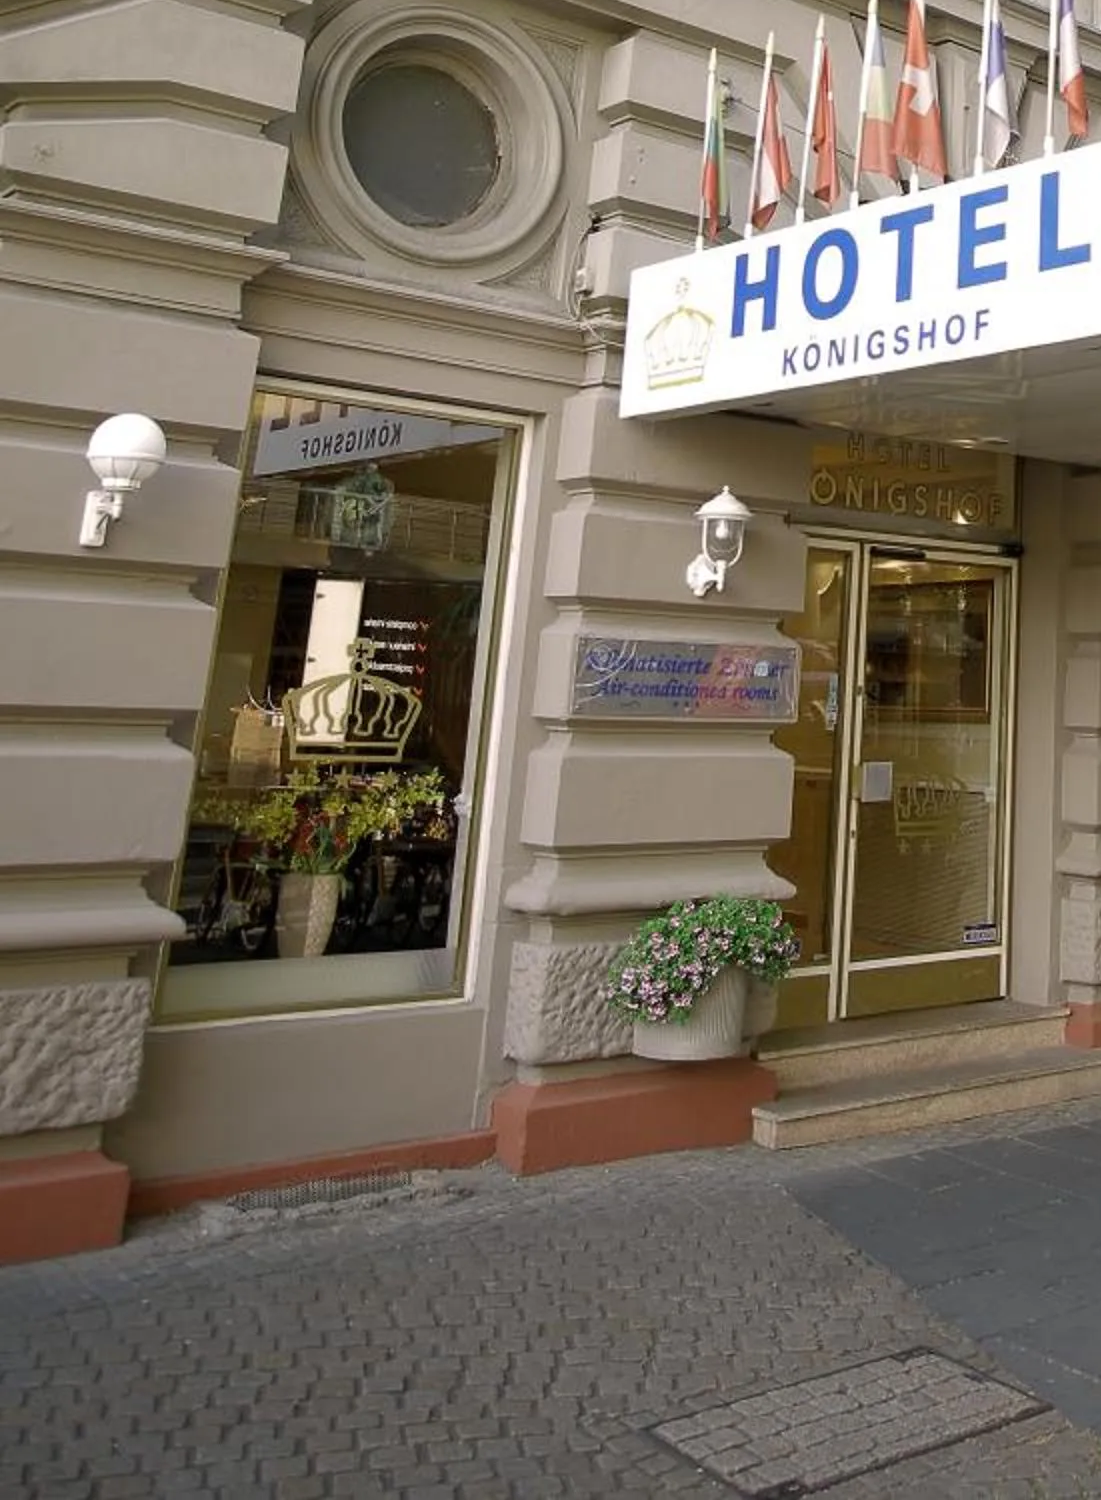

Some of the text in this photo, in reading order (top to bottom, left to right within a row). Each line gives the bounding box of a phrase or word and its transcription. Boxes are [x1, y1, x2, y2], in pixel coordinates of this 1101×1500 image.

[730, 170, 1092, 338] HOTEL
[781, 307, 991, 377] KÖNIGSHOF
[810, 466, 1004, 527] ÖNIGSHOF
[733, 684, 779, 701] rooms
